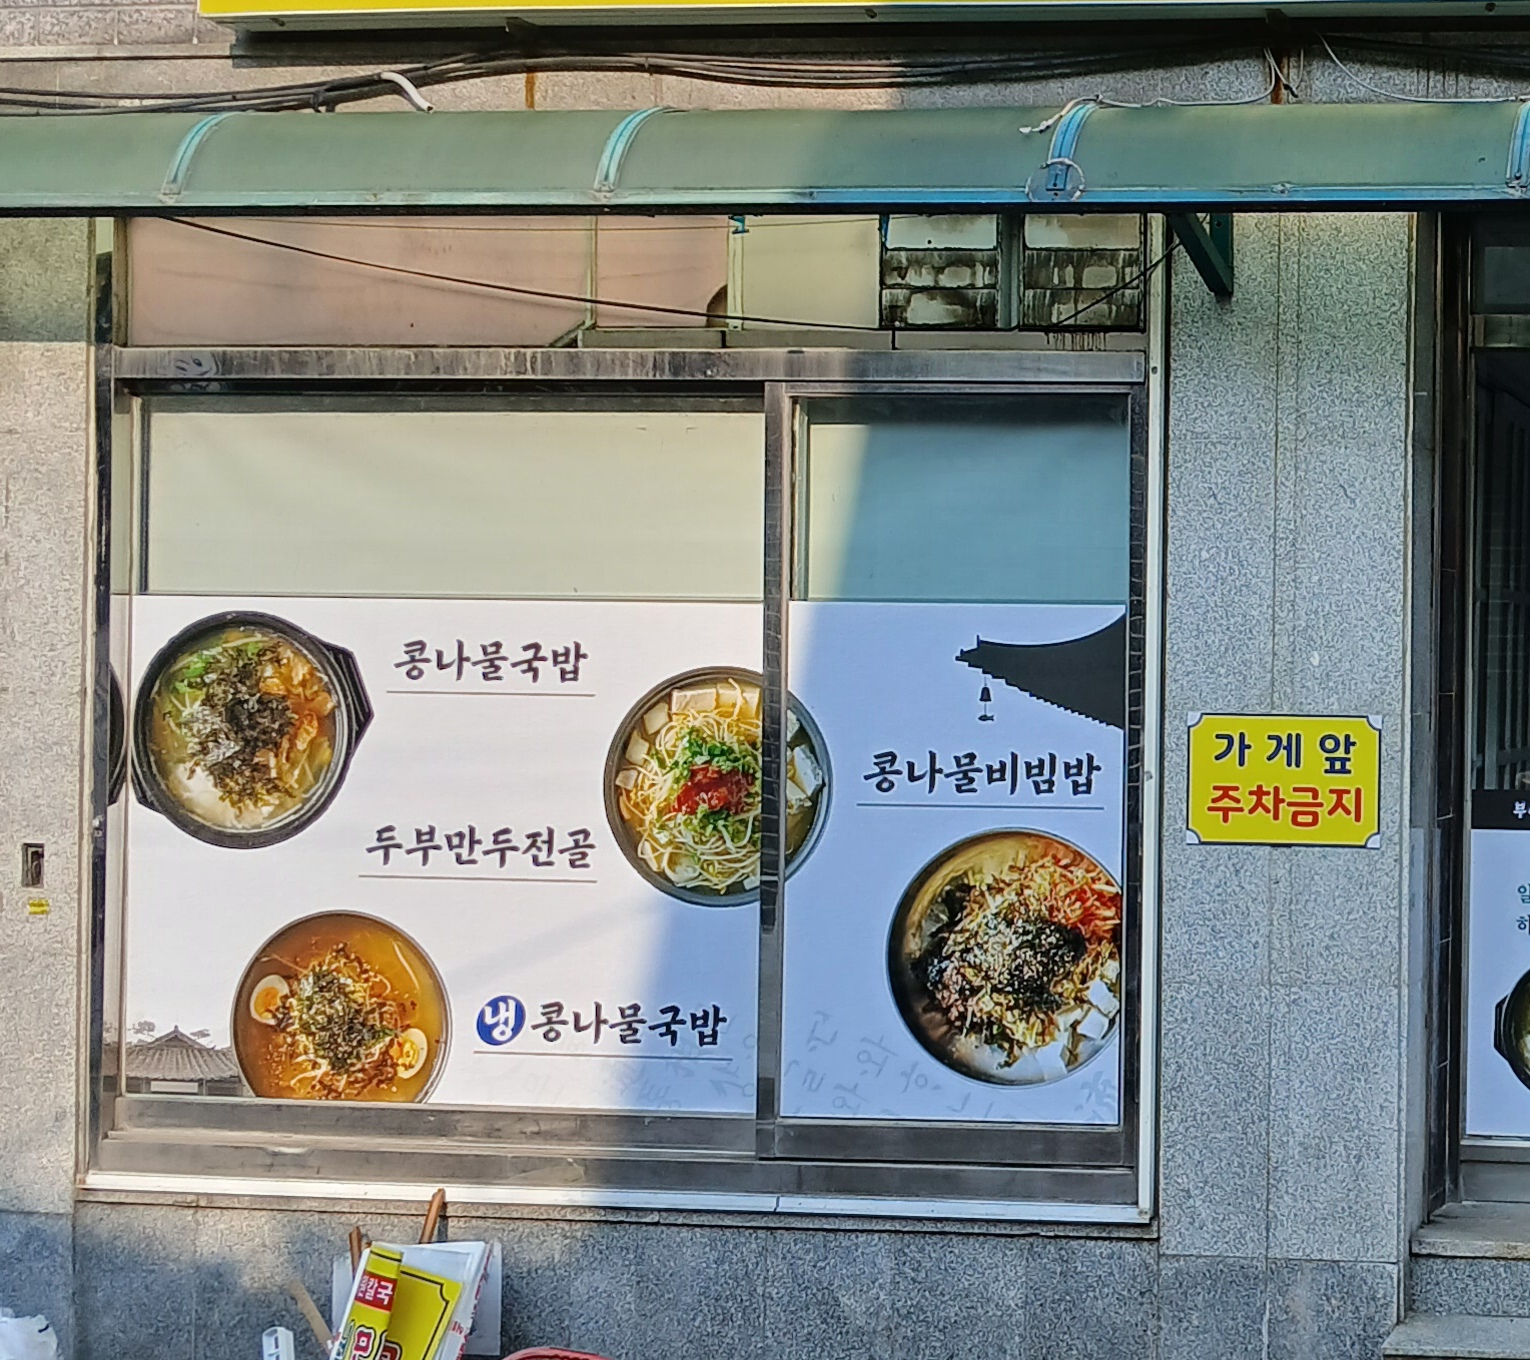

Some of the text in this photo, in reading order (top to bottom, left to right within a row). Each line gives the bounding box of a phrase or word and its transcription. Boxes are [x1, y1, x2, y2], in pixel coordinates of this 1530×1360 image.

[393, 639, 589, 682] 콩나물국밥
[863, 750, 1102, 797] 콩나물비빔밥
[1206, 784, 1363, 828] 주차금지
[365, 824, 597, 870] 두부만두전골
[483, 1000, 727, 1048] 냉 콩나물국밥
